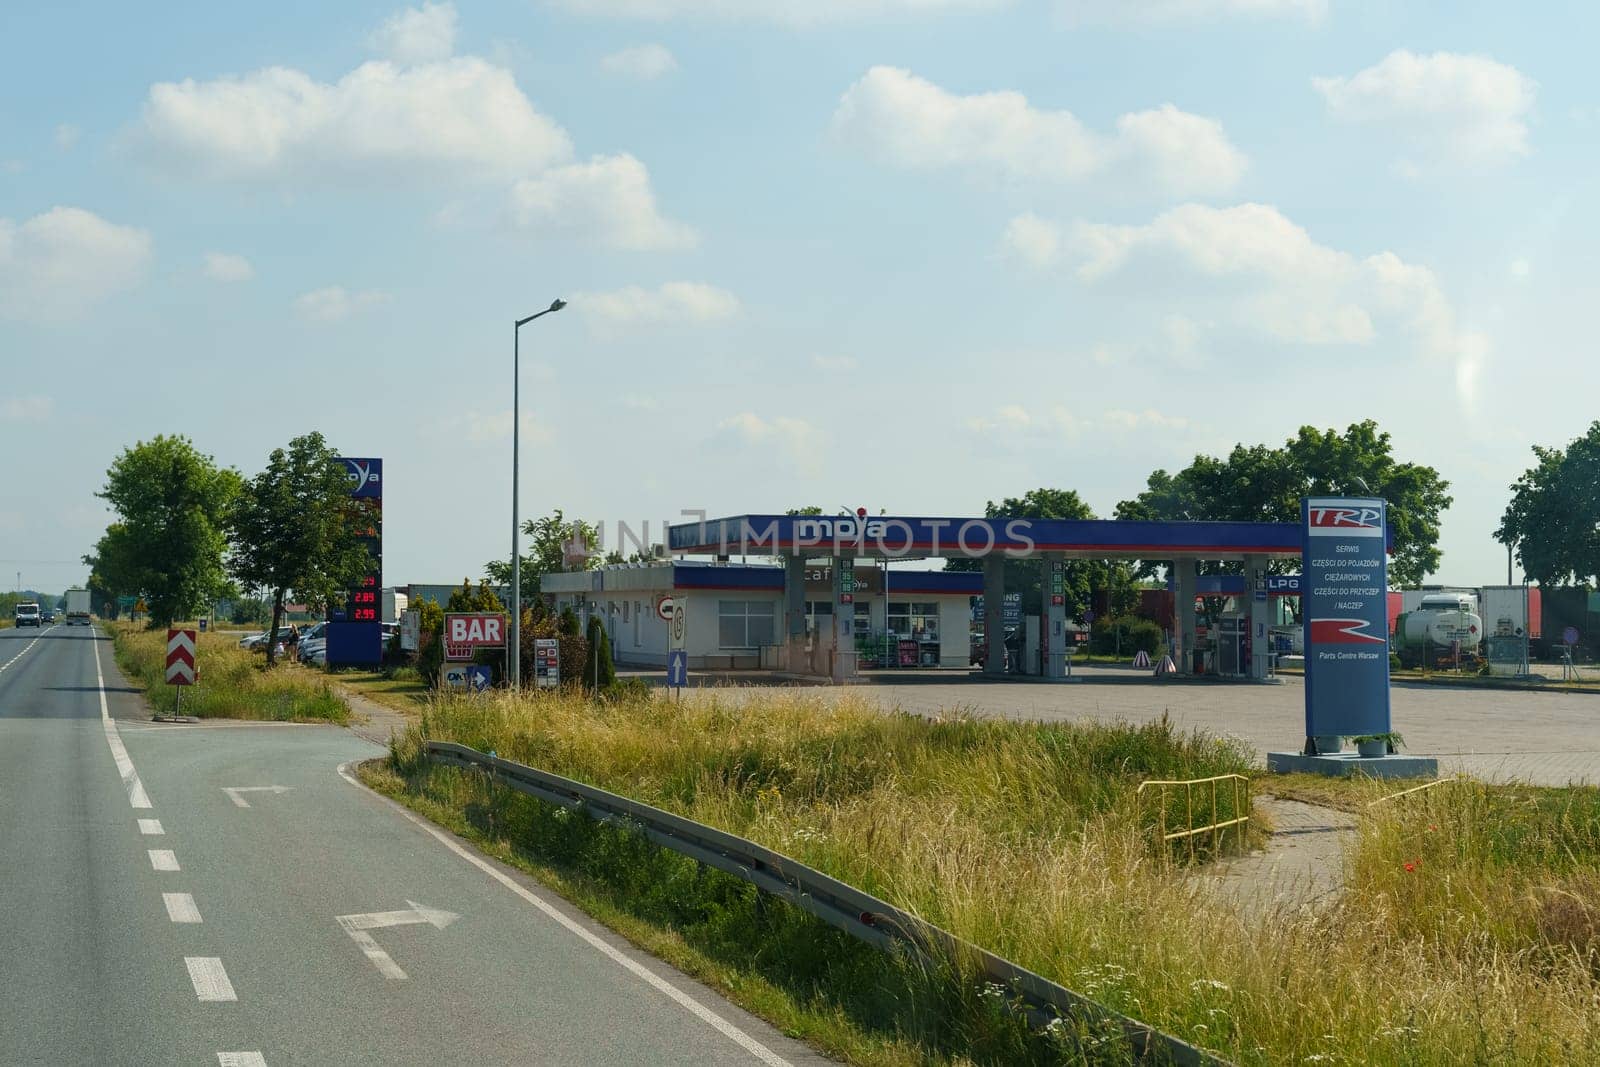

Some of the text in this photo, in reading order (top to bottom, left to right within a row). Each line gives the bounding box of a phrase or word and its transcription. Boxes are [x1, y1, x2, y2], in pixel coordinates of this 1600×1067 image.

[1310, 507, 1380, 528] TRP
[1336, 545, 1360, 553] SERWIS
[1312, 558, 1335, 568] CZĘŚCI
[1348, 558, 1379, 567] POJAZDÓW
[1269, 579, 1299, 588] LPG
[1314, 586, 1338, 596] CZĘŚCI
[1350, 587, 1379, 596] PRZYCZEP
[1338, 602, 1363, 610] NACZEP
[452, 619, 500, 641] BAR
